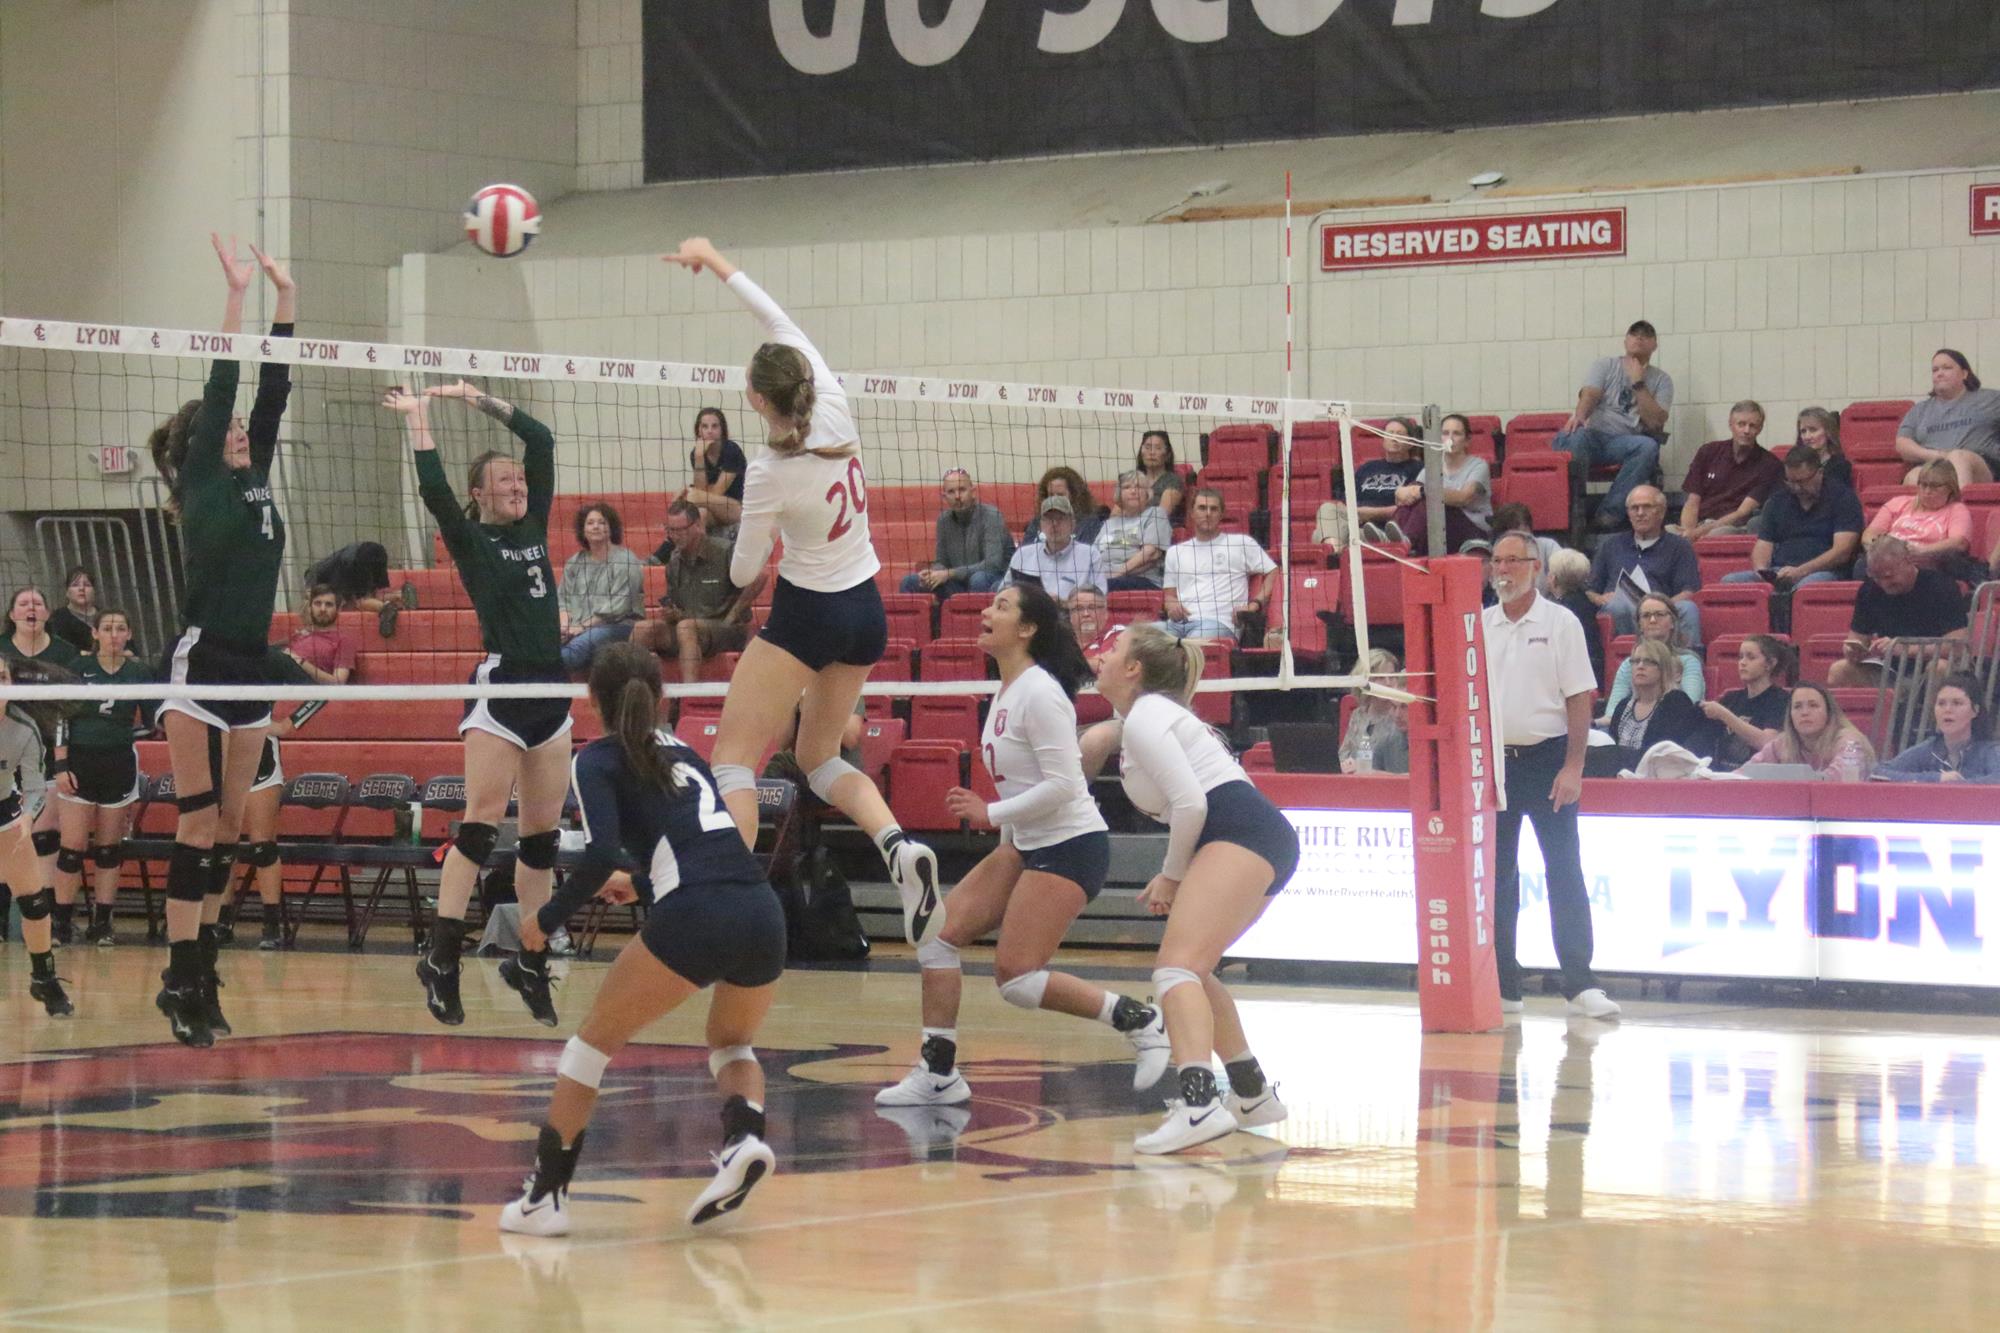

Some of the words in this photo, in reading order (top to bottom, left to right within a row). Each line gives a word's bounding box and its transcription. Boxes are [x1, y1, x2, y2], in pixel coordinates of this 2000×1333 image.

[1333, 228, 1480, 258] RESERVED
[1486, 219, 1612, 250] SEATING
[76, 327, 120, 346] LYON
[190, 335, 232, 353] LYON
[299, 342, 339, 360] LYON
[404, 349, 442, 367] LYON
[503, 356, 541, 373] LYON
[600, 361, 635, 378] LYON
[691, 367, 726, 384] LYON
[864, 378, 897, 394] LYON
[948, 383, 978, 398] LYON
[1027, 387, 1057, 403] LYON
[1104, 392, 1133, 407] LYON
[1179, 395, 1208, 411] LYON
[1251, 400, 1278, 414] LYON
[103, 447, 125, 470] EXIT
[825, 456, 866, 543] 20
[261, 505, 274, 540] 4
[501, 544, 546, 561] PIONEE
[527, 565, 547, 598] 3
[292, 780, 340, 798] SCOTS
[359, 778, 405, 798] SCOTS
[756, 787, 784, 805] OTS
[1463, 612, 1488, 945] VOLLEYBALL
[671, 761, 737, 833] 2
[1295, 826, 1346, 847] HITE
[1357, 827, 1412, 848] RIVE
[1663, 834, 1984, 953] LYON
[1428, 898, 1451, 985] Senoh
